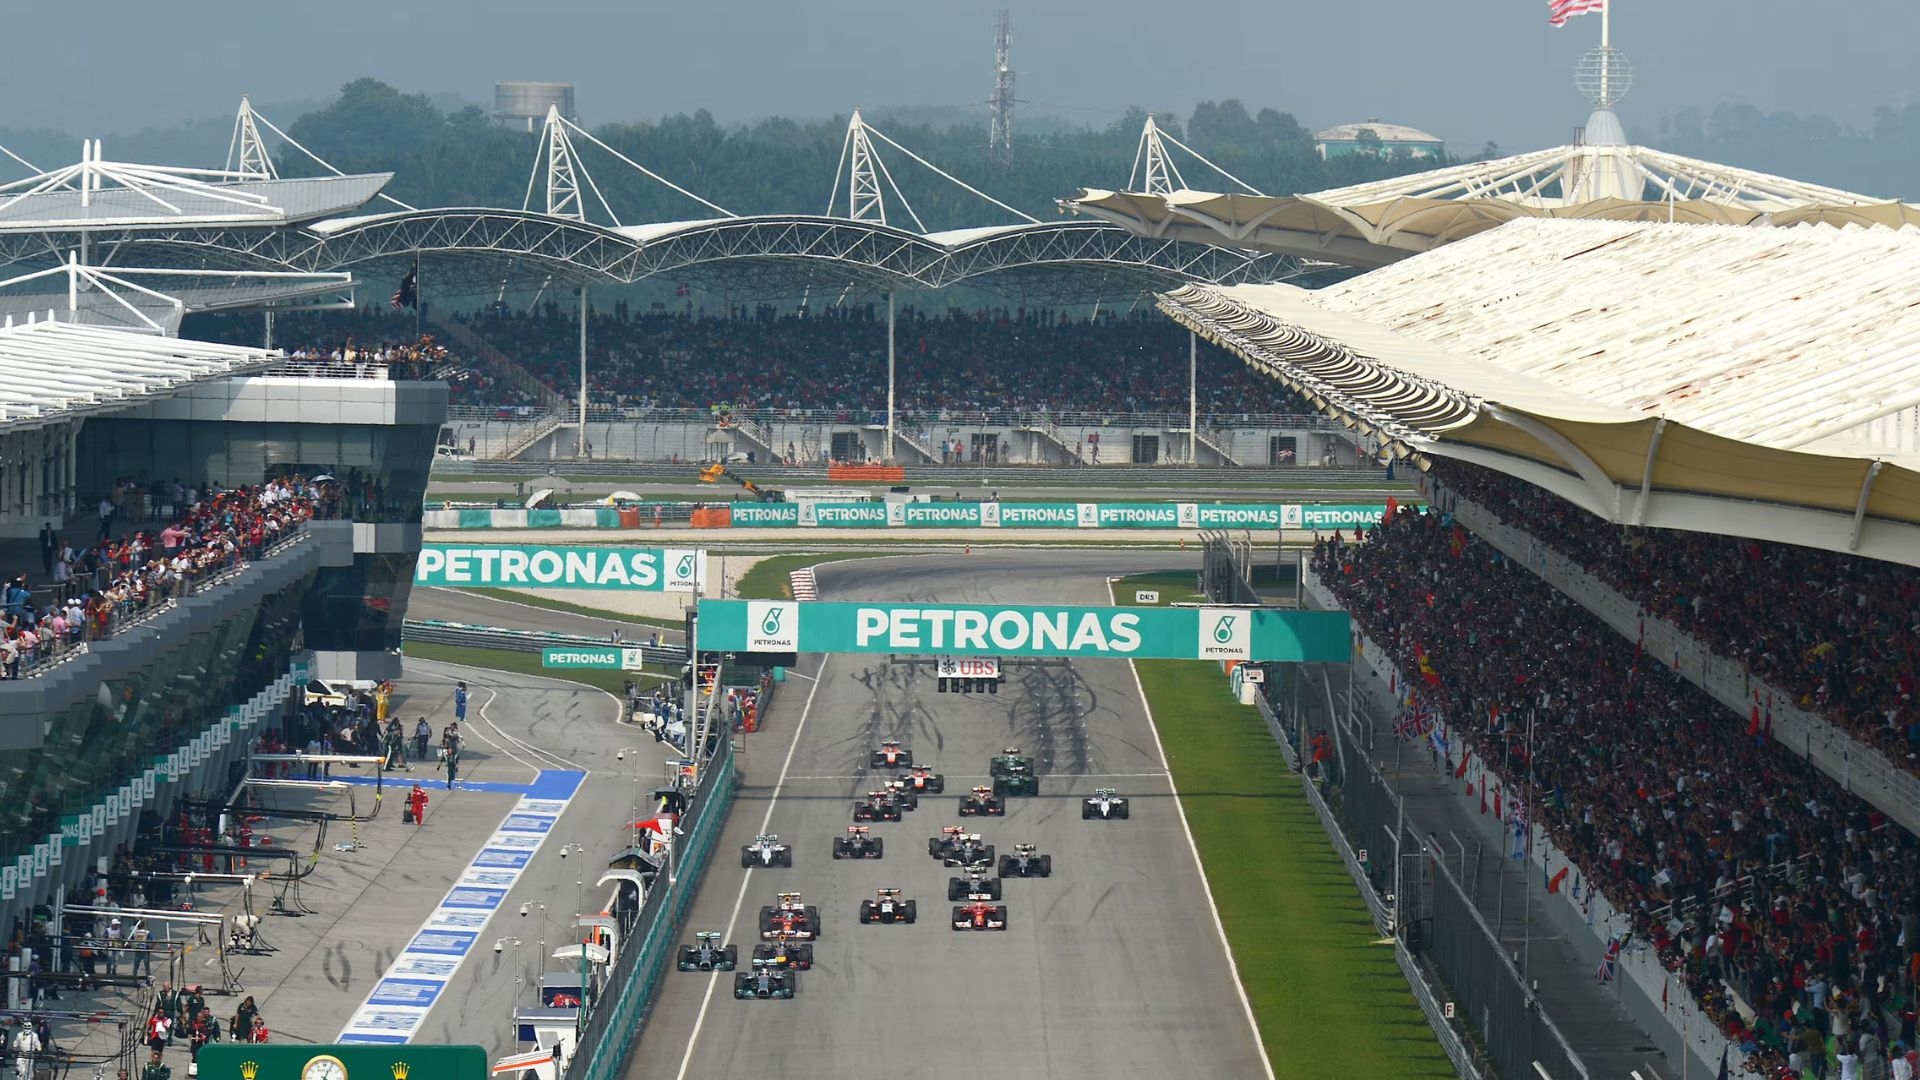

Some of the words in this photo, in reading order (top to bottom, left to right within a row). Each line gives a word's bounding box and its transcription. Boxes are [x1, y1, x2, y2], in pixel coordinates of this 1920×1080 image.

[733, 508, 797, 521] PETRONAS
[818, 508, 885, 521] PETRONAS
[907, 508, 979, 521] PETRONAS
[1002, 508, 1075, 521] PETRONAS
[1101, 509, 1176, 522] PETRONAS
[1200, 509, 1278, 523] PETRONAS
[1304, 511, 1382, 524] PETRONAS
[418, 549, 657, 586] PETRONAS
[857, 608, 1141, 652] PETRONAS
[549, 653, 615, 664] PETRONAS
[960, 660, 995, 675] UBS
